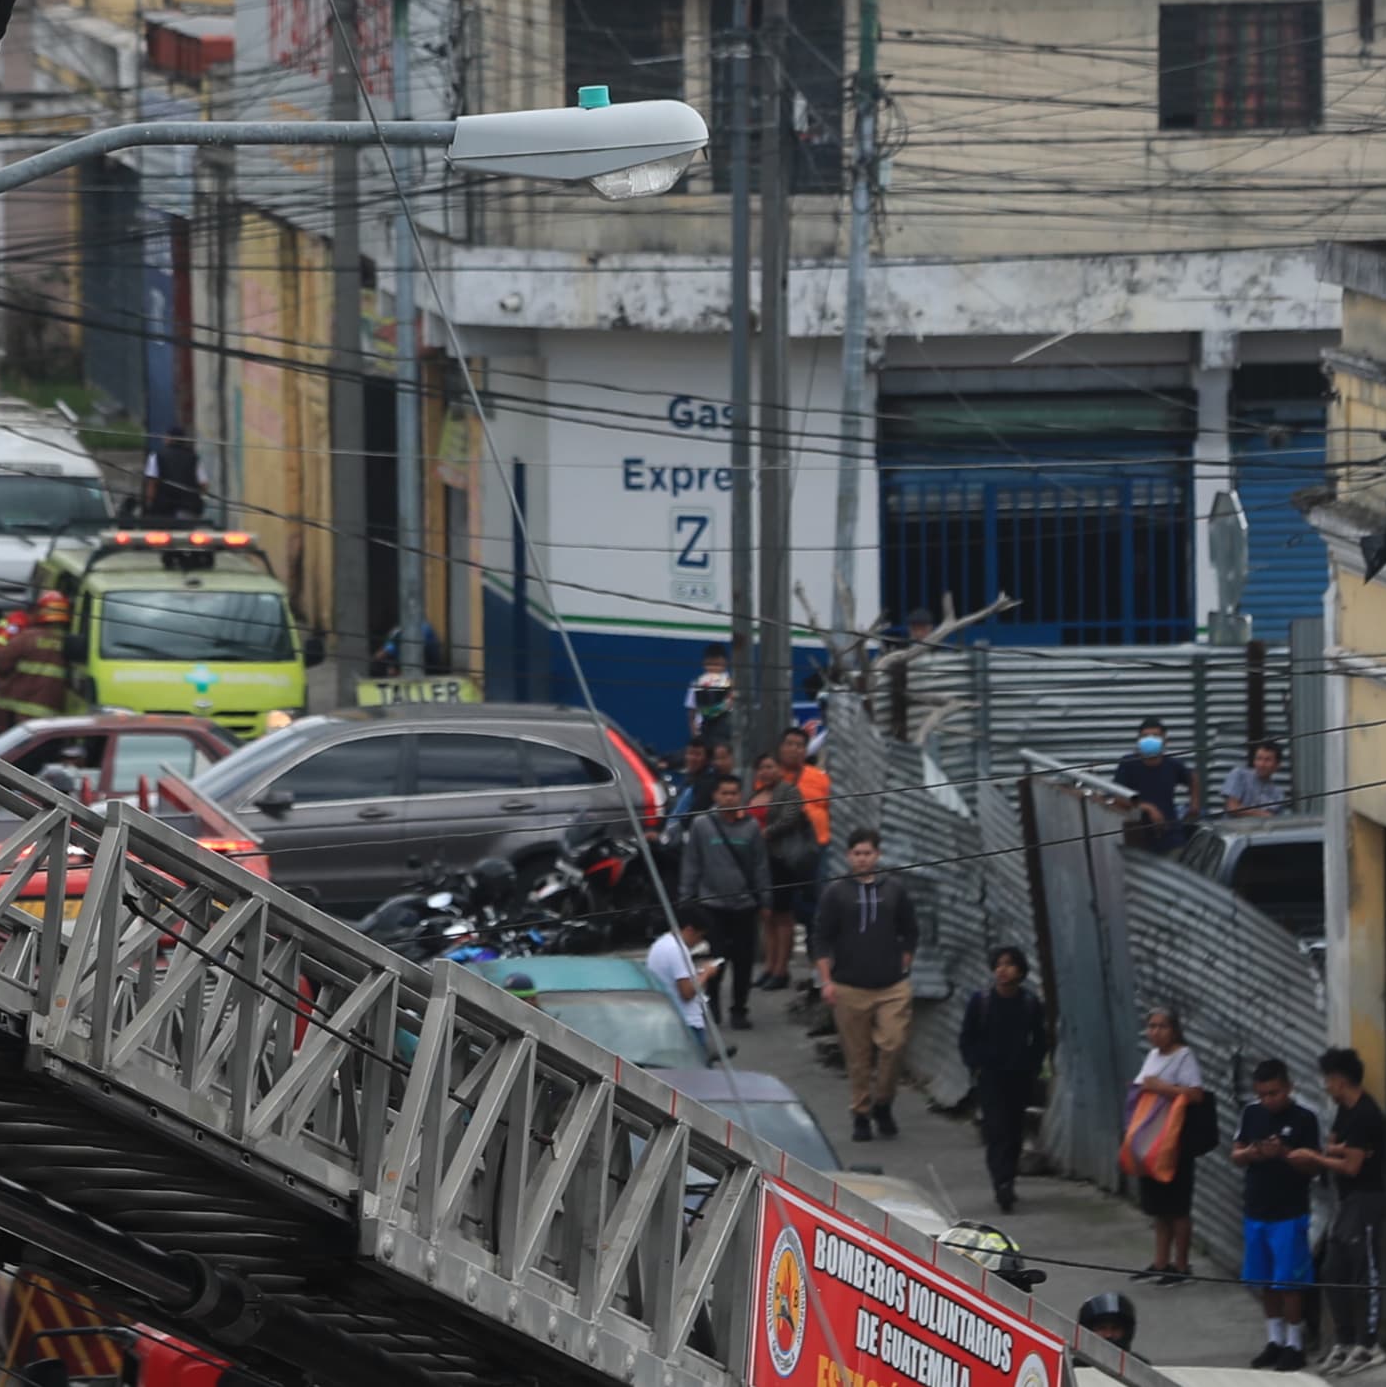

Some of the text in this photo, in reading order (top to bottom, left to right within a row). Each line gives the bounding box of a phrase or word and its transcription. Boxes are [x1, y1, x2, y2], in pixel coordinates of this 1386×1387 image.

[623, 459, 735, 498] Expre
[676, 516, 710, 569] Z
[376, 682, 460, 704] TALLER
[814, 1228, 907, 1313] BOMBEROS
[908, 1279, 1013, 1373] VOLUNTARIOS
[856, 1308, 879, 1356] DE
